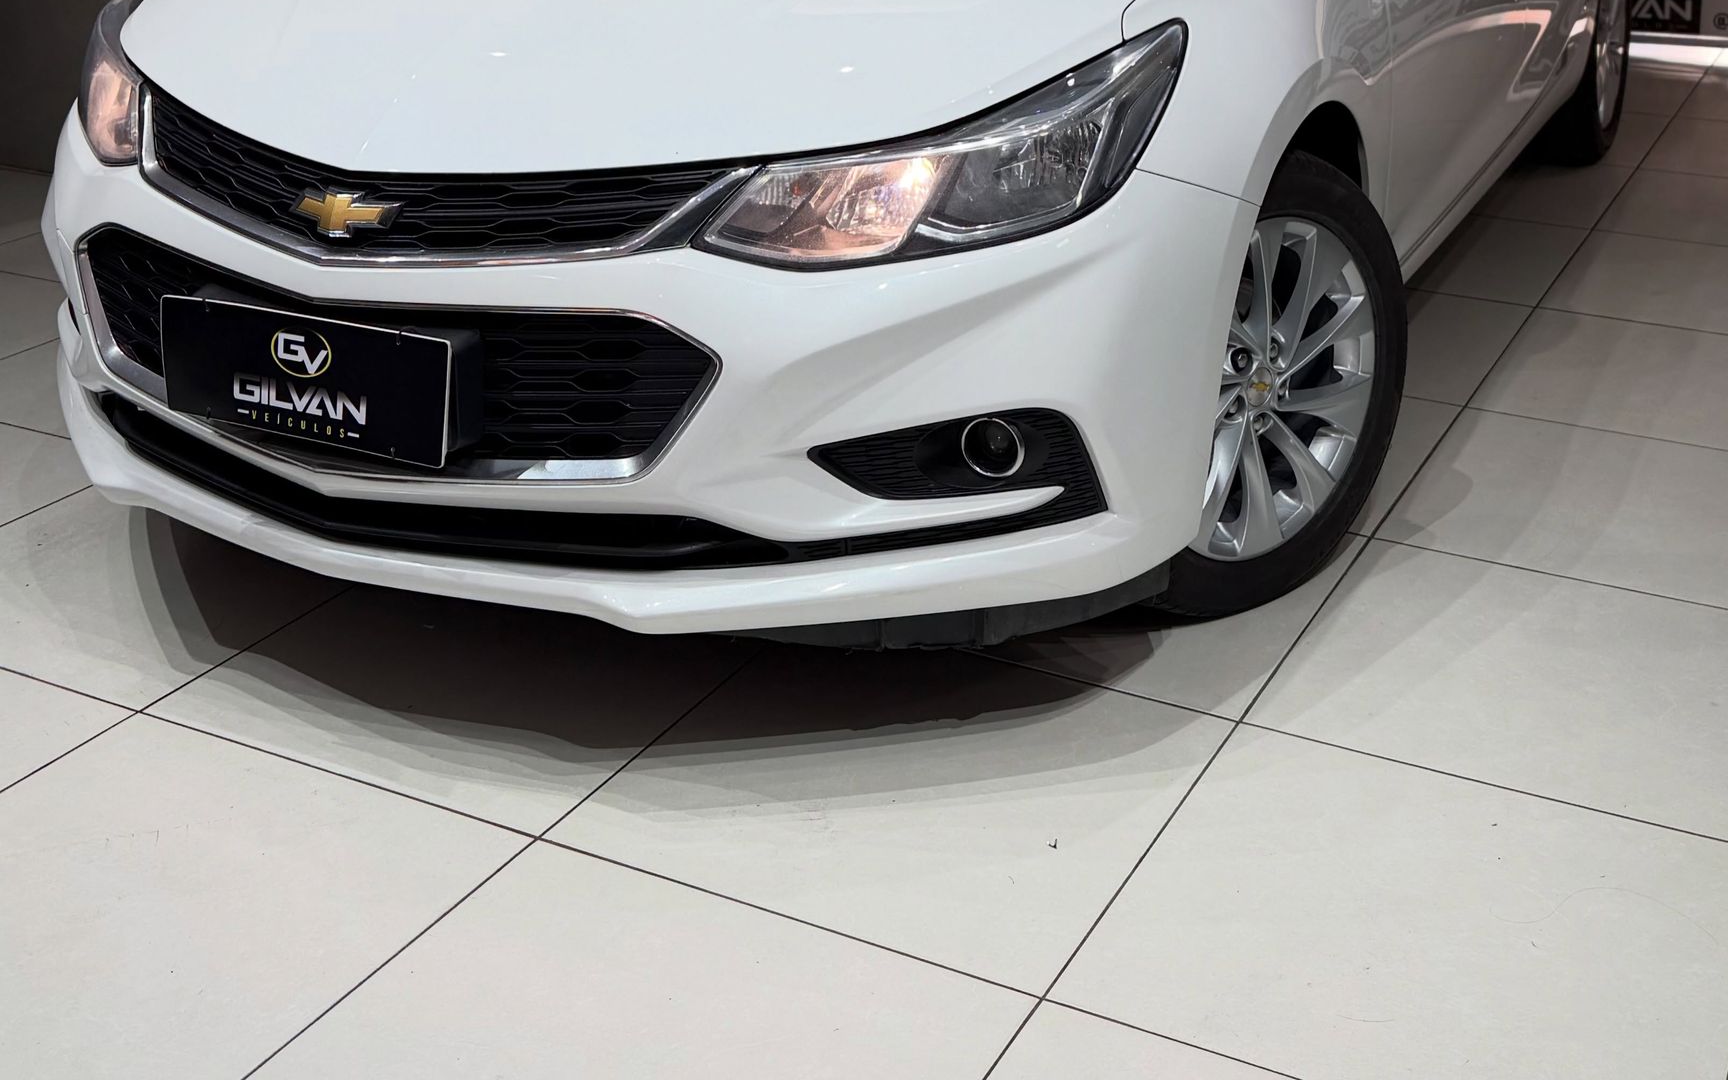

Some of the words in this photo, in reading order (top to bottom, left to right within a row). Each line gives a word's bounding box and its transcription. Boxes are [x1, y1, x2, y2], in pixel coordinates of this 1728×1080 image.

[277, 332, 329, 375] GV
[233, 372, 368, 426] GILVAN
[251, 410, 346, 439] VEÍCULOS
